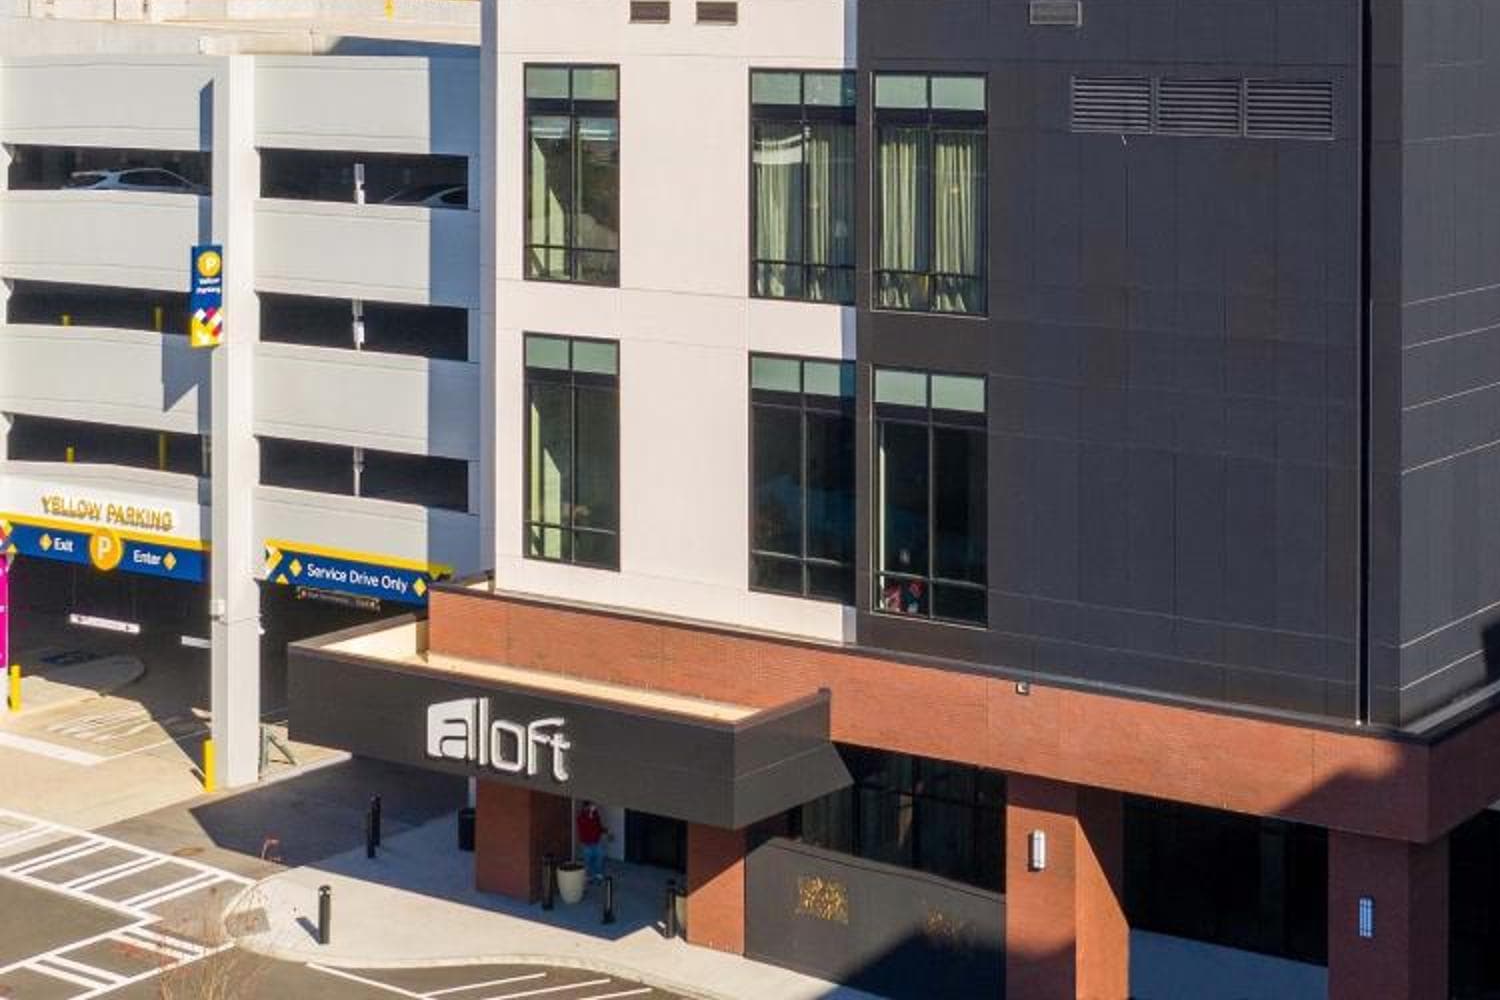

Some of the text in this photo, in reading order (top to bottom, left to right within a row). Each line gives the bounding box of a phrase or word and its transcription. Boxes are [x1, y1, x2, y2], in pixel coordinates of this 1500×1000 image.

[41, 495, 173, 531] YELLOW PARKING
[53, 537, 74, 553] Exit
[97, 537, 113, 560] P
[133, 549, 162, 565] Enter
[307, 563, 409, 594] Service Drive Only
[426, 697, 572, 782] aloft
